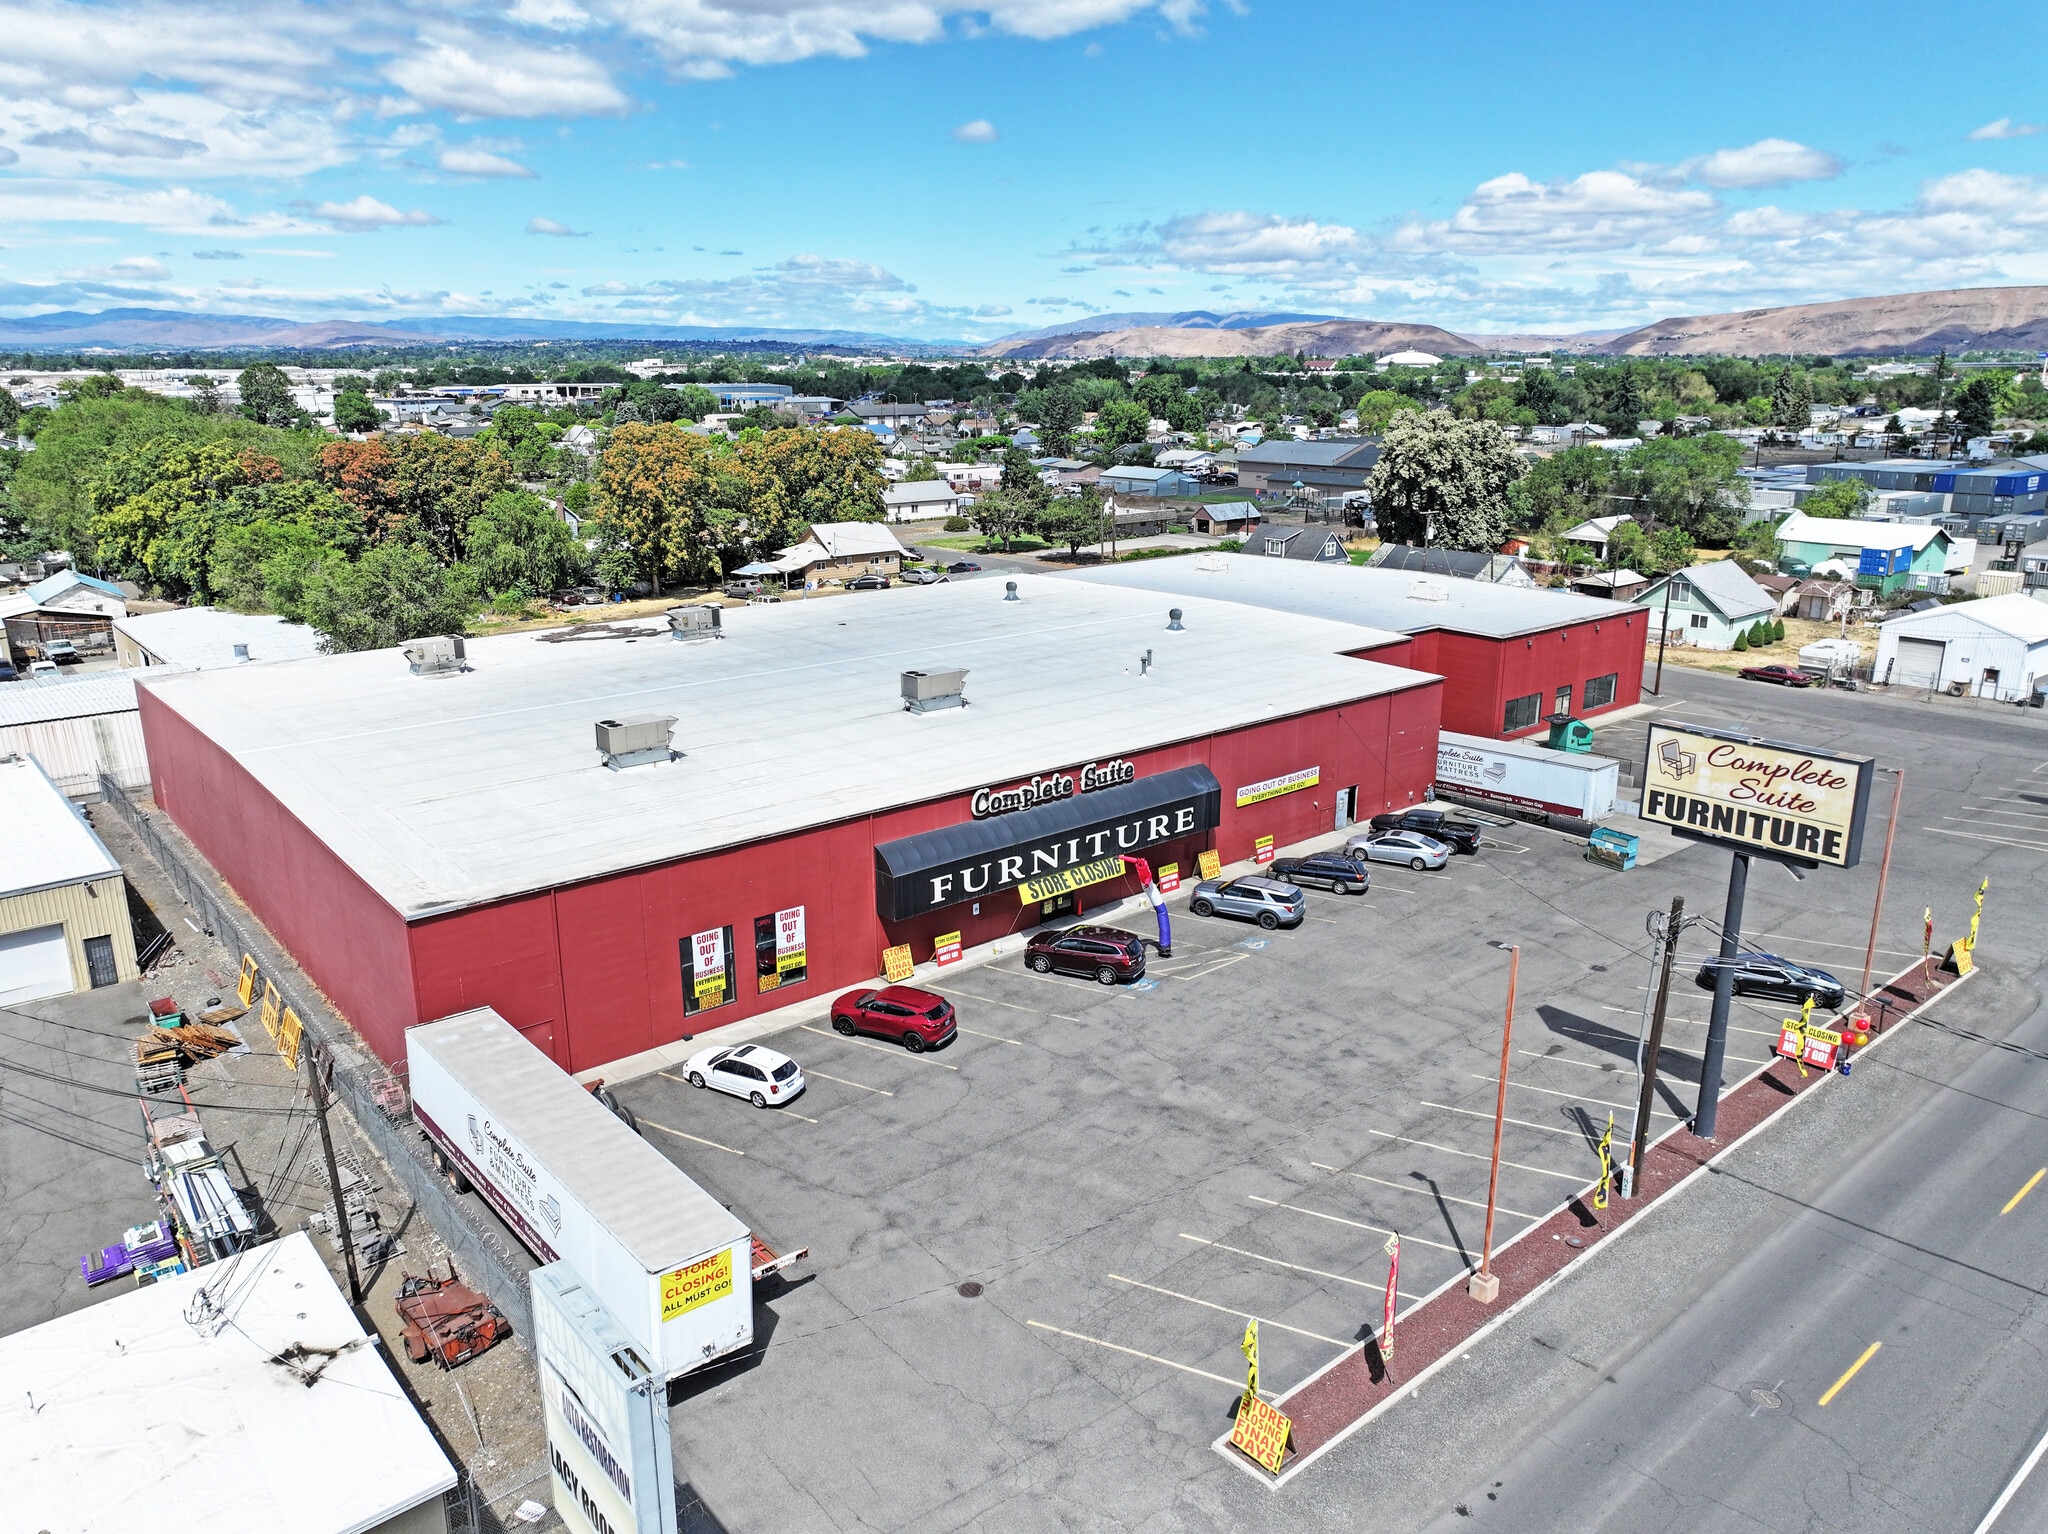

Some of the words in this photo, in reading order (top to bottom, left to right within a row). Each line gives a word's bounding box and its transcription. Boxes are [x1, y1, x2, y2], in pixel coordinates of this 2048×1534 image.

[1708, 745, 1848, 790] Complete
[973, 775, 1074, 817] Complete
[1081, 760, 1134, 790] Suite
[1239, 786, 1261, 796] GOING
[1262, 781, 1276, 790] OUT
[1277, 778, 1287, 786] OF
[1288, 768, 1318, 782] BUSINESS
[1251, 788, 1283, 802] EVERYTHING
[1283, 784, 1296, 792] MUST
[1730, 778, 1816, 813] Suite
[1648, 789, 1843, 859] FURNITURE
[930, 806, 1195, 904] FURNITURE
[1200, 850, 1218, 860] STORE
[1202, 864, 1220, 872] FINAL
[1203, 869, 1221, 880] DAYS
[1027, 870, 1068, 900] STORE
[1070, 856, 1122, 890] CLOSING
[780, 909, 800, 922] GOING
[782, 920, 798, 932] OUT
[696, 931, 719, 945] GOING
[786, 933, 796, 943] OF
[700, 942, 716, 956] OUT
[778, 942, 804, 956] BUSINESS
[884, 945, 910, 958] STORE
[704, 956, 714, 967] OF
[780, 962, 794, 971] MUST
[886, 954, 911, 966] CLOSING
[888, 961, 912, 973] FINAL
[695, 965, 724, 980] BUSINESS
[888, 967, 914, 980] DAYS
[699, 986, 713, 996] MUST
[1808, 1028, 1838, 1042] CLOSING
[1812, 1050, 1830, 1064] GO!
[484, 1120, 515, 1160] Complete
[516, 1152, 537, 1183] Suite
[674, 1255, 718, 1281] STORE
[665, 1266, 728, 1300] CLOSING!
[664, 1301, 682, 1314] ALL
[685, 1288, 712, 1304] MUST
[714, 1280, 732, 1292] GO!
[1240, 1406, 1282, 1443] CLOSING
[1236, 1418, 1276, 1456] FINAL
[562, 1390, 581, 1437] AUTO
[580, 1416, 632, 1506] RESTORATION
[550, 1440, 578, 1501] LACY
